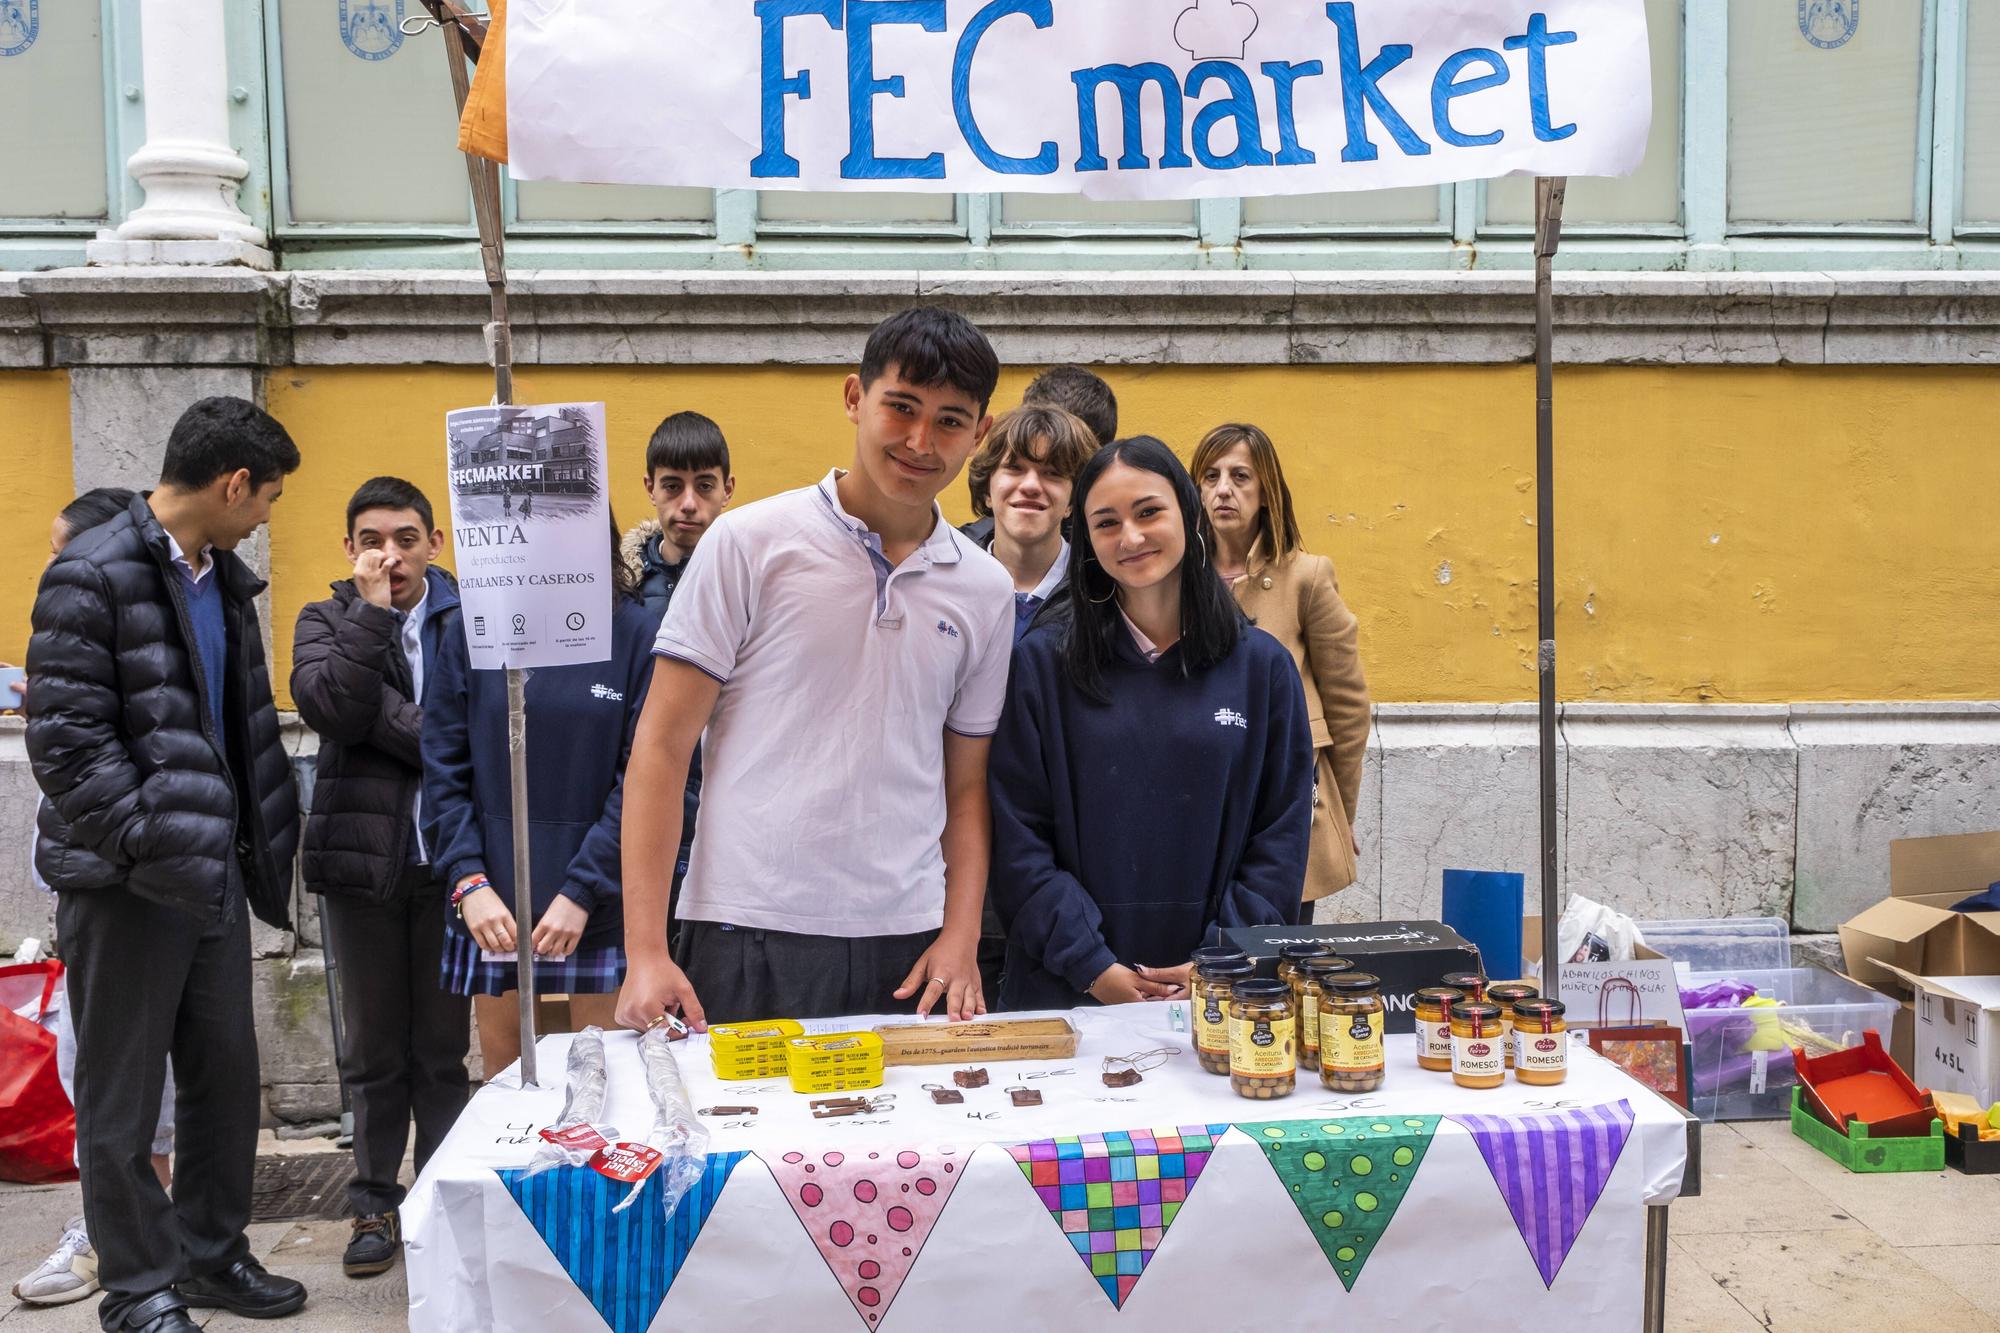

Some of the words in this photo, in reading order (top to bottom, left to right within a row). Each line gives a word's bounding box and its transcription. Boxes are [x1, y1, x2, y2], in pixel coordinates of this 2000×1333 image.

[452, 464, 543, 485] FECMARKET
[456, 524, 529, 548] VENTA
[478, 554, 526, 568] productos
[460, 575, 514, 589] CATALANES
[516, 575, 526, 586] Y
[528, 573, 595, 585] CASEROS
[948, 625, 959, 638] fec
[606, 688, 623, 701] fec
[1429, 1042, 1451, 1050] ROME
[1461, 1060, 1498, 1069] ROMESCO
[1526, 1055, 1564, 1064] ROMESCO
[722, 1121, 758, 1129] 2€
